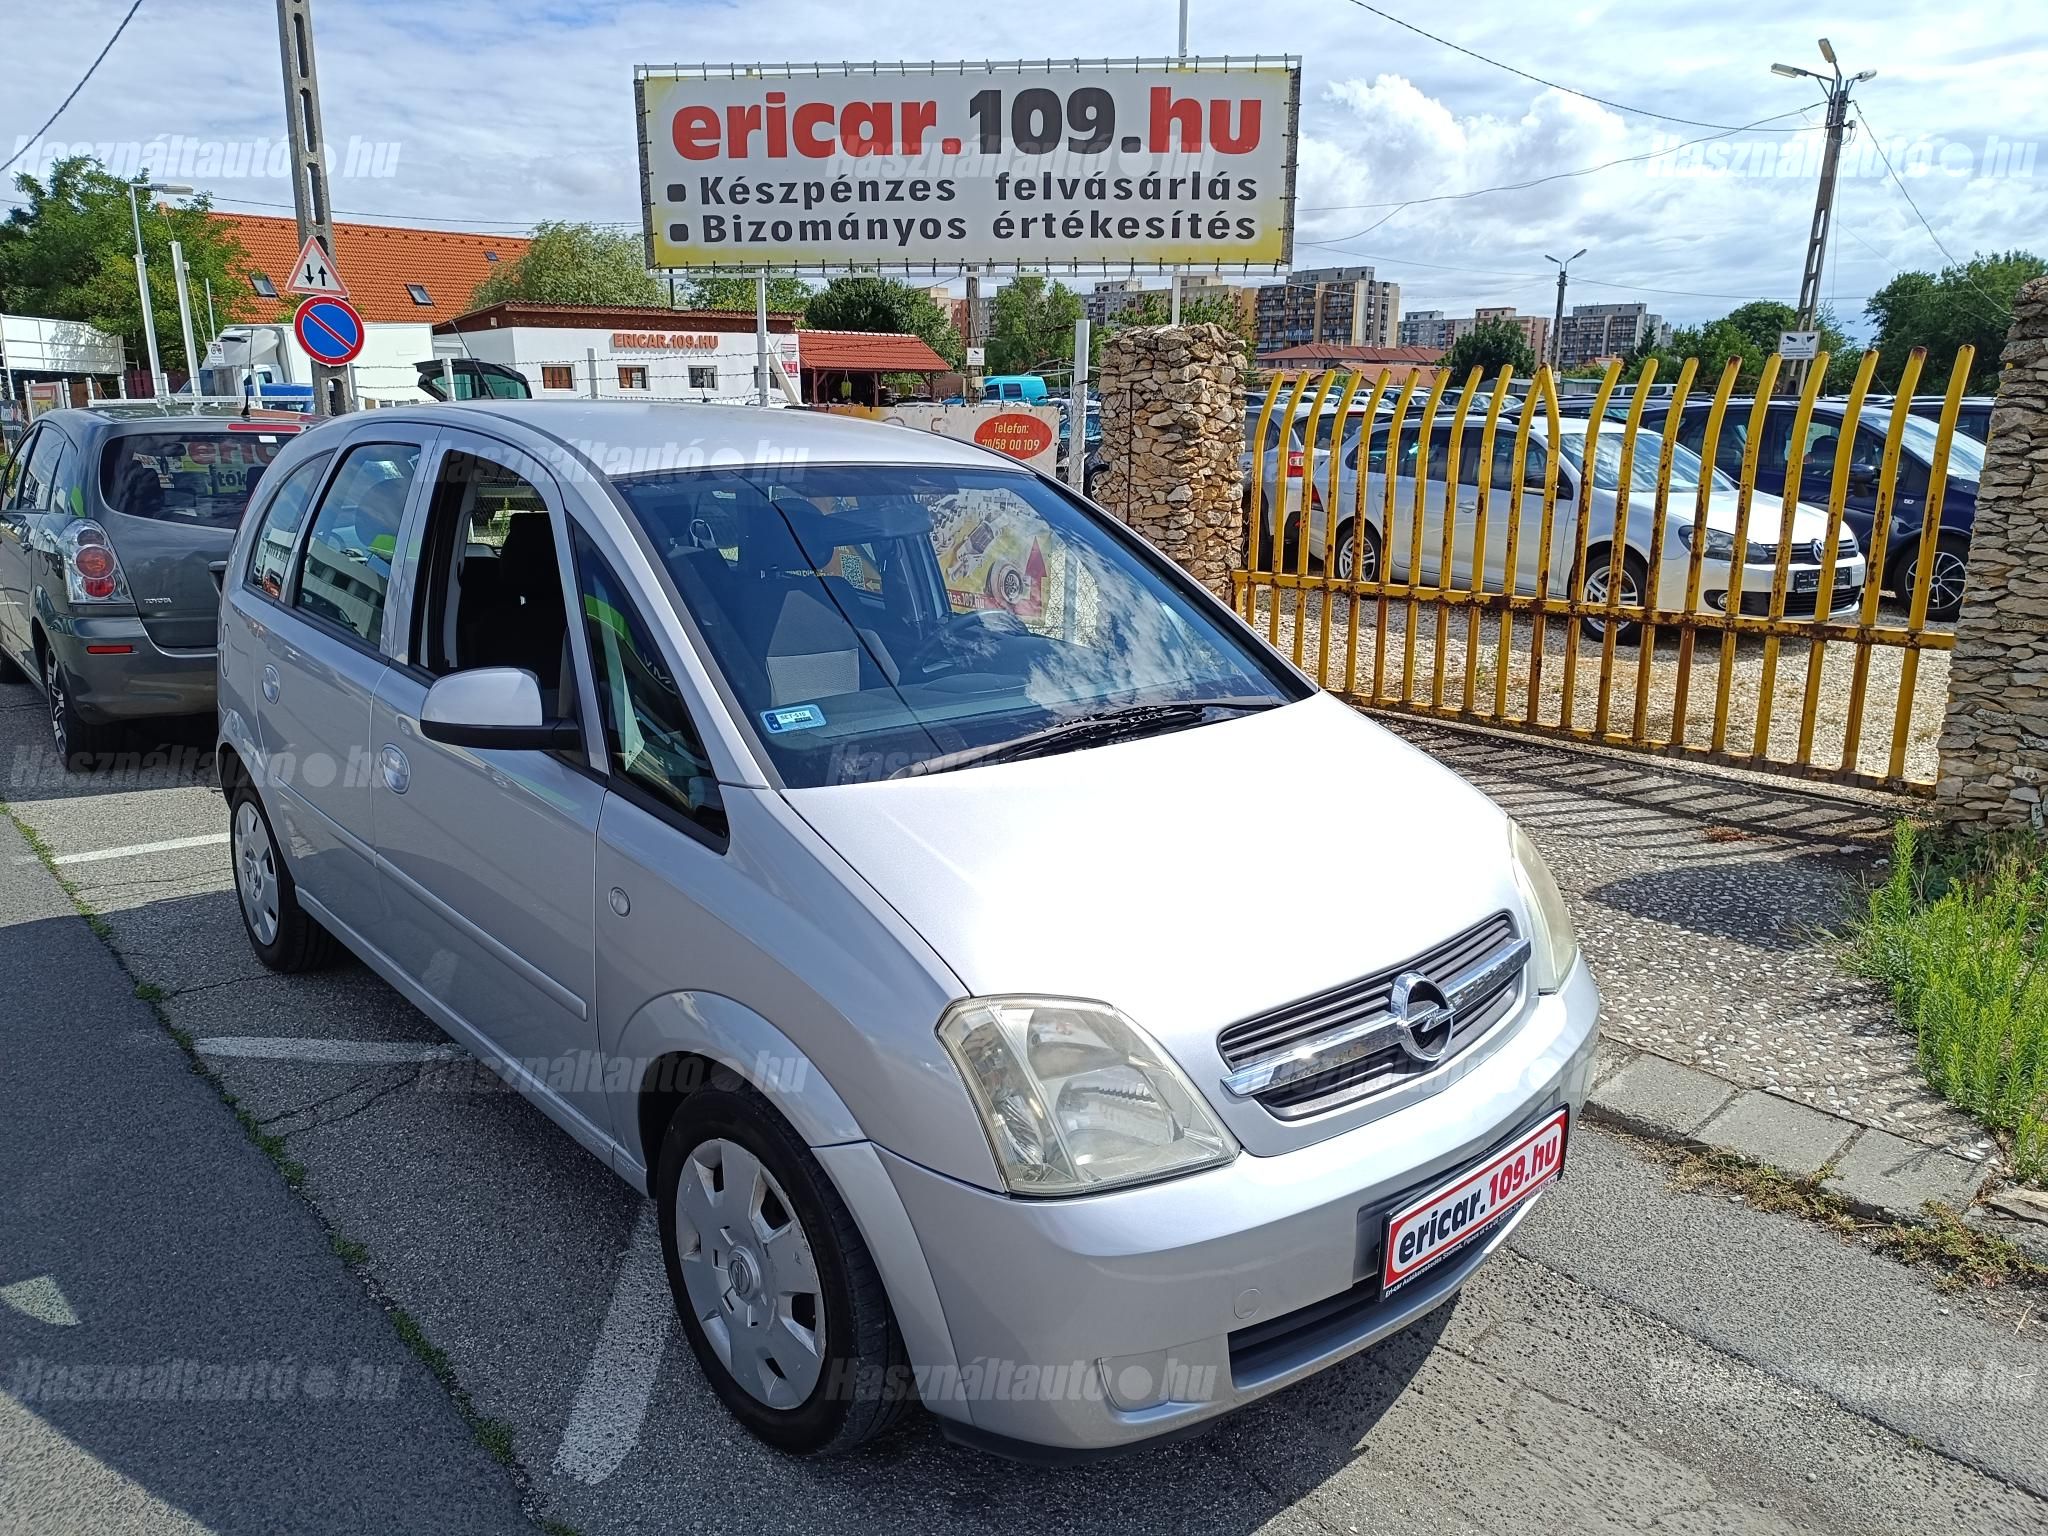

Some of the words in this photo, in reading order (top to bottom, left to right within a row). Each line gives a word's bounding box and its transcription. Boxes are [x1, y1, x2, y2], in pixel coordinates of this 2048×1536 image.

[672, 86, 1262, 160] ericar.109.hu
[700, 174, 957, 210] Készpénzes
[995, 170, 1258, 201] felvásárlás
[702, 212, 967, 247] Bizományos
[992, 209, 1256, 240] értékesítés
[613, 333, 719, 350] ERICAR.109.HU
[994, 422, 1030, 434] Telefon:
[1009, 440, 1021, 450] 00
[1023, 440, 1040, 451] 109
[1399, 1135, 1557, 1264] ericar.109.hu
